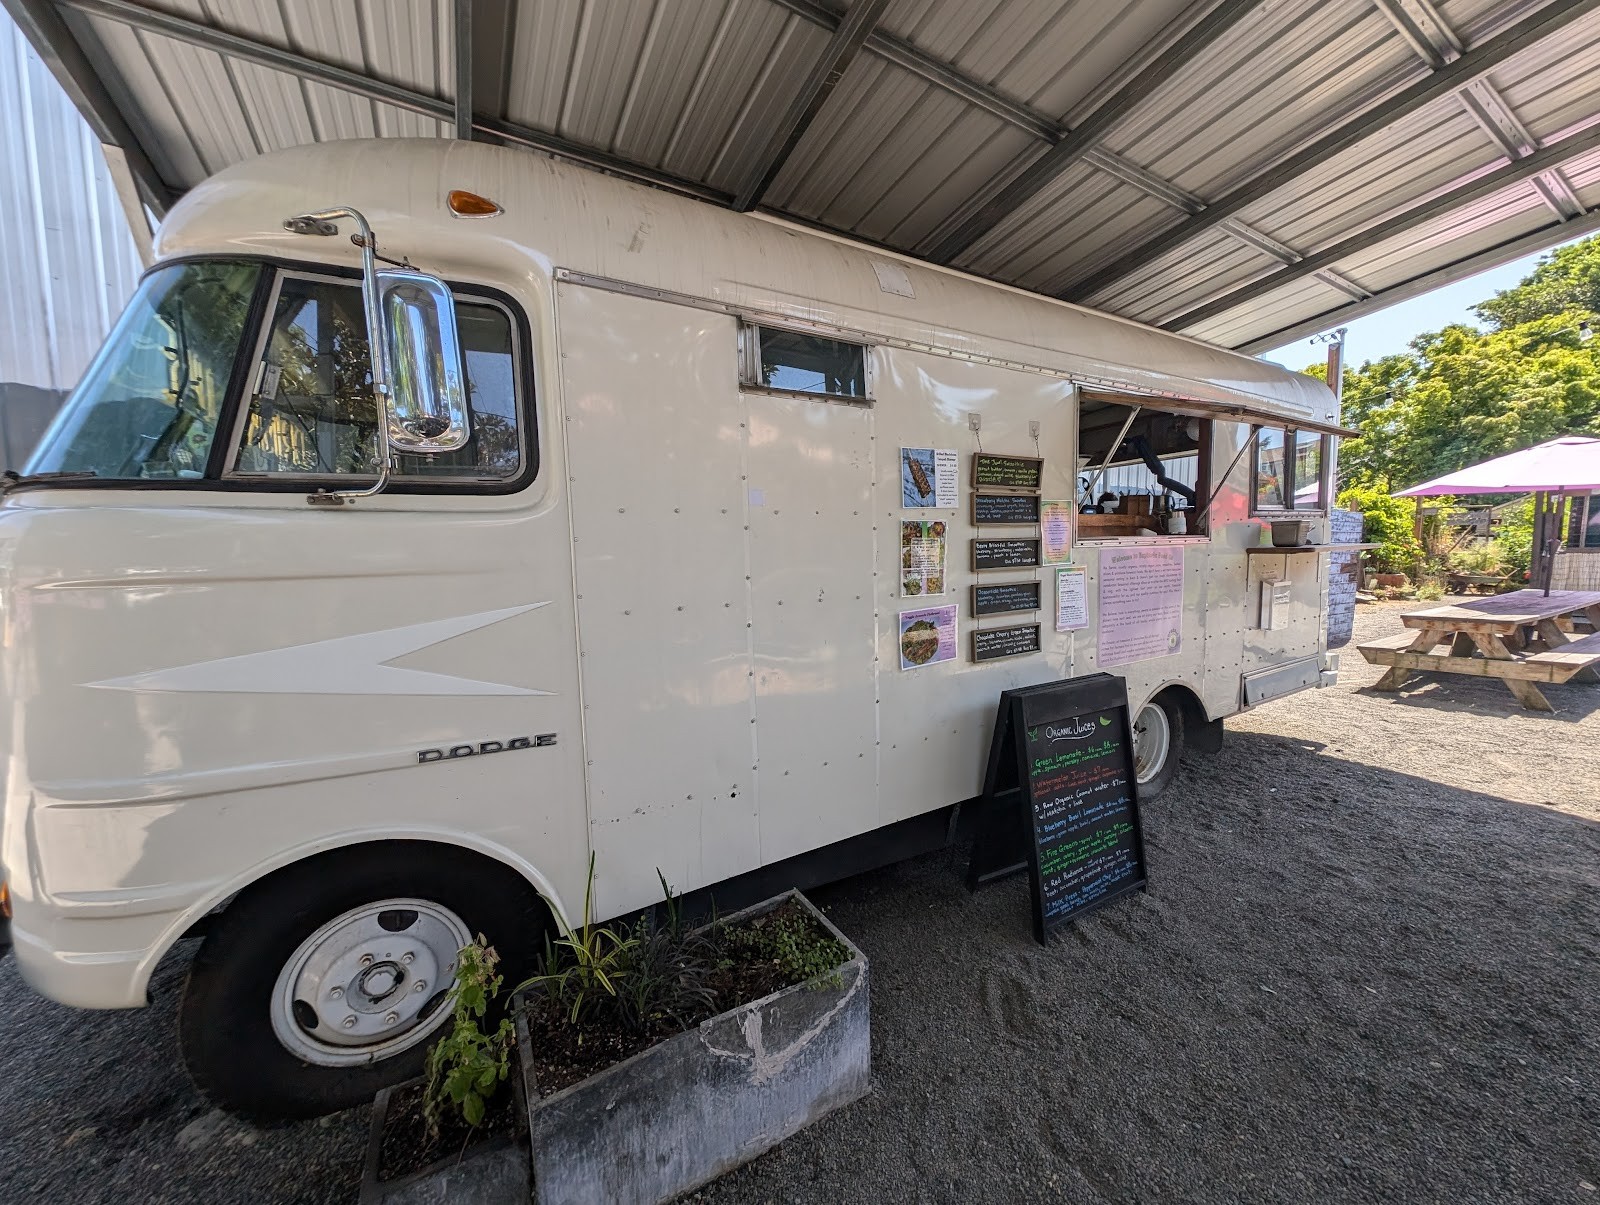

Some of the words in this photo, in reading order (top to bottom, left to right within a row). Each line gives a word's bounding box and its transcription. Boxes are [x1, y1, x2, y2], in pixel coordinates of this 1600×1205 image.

[416, 732, 557, 764] DODGE
[1035, 758, 1053, 768] Green
[1050, 877, 1062, 887] Red
